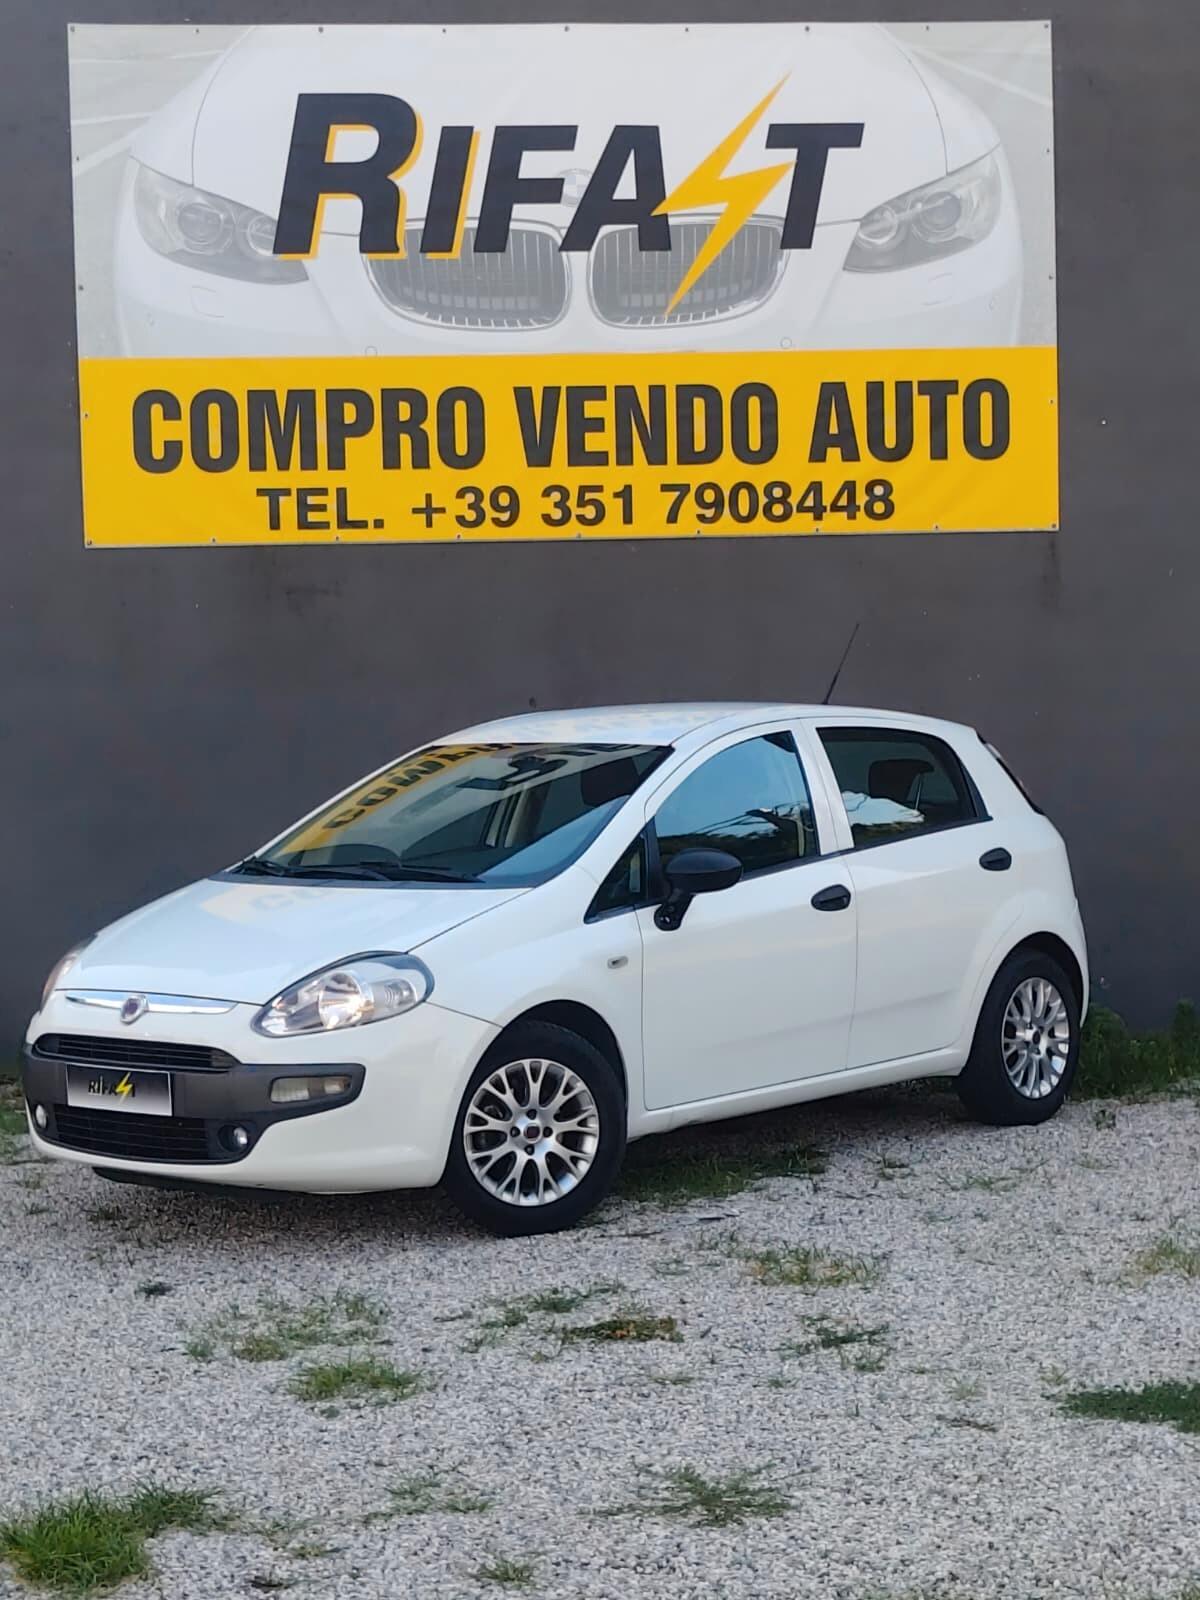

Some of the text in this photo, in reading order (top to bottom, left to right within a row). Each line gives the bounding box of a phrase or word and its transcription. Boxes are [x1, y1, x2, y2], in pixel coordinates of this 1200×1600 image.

[132, 378, 1011, 474] COMPRO VENDO AUTO
[255, 478, 896, 530] TEL. +39 351 7908448
